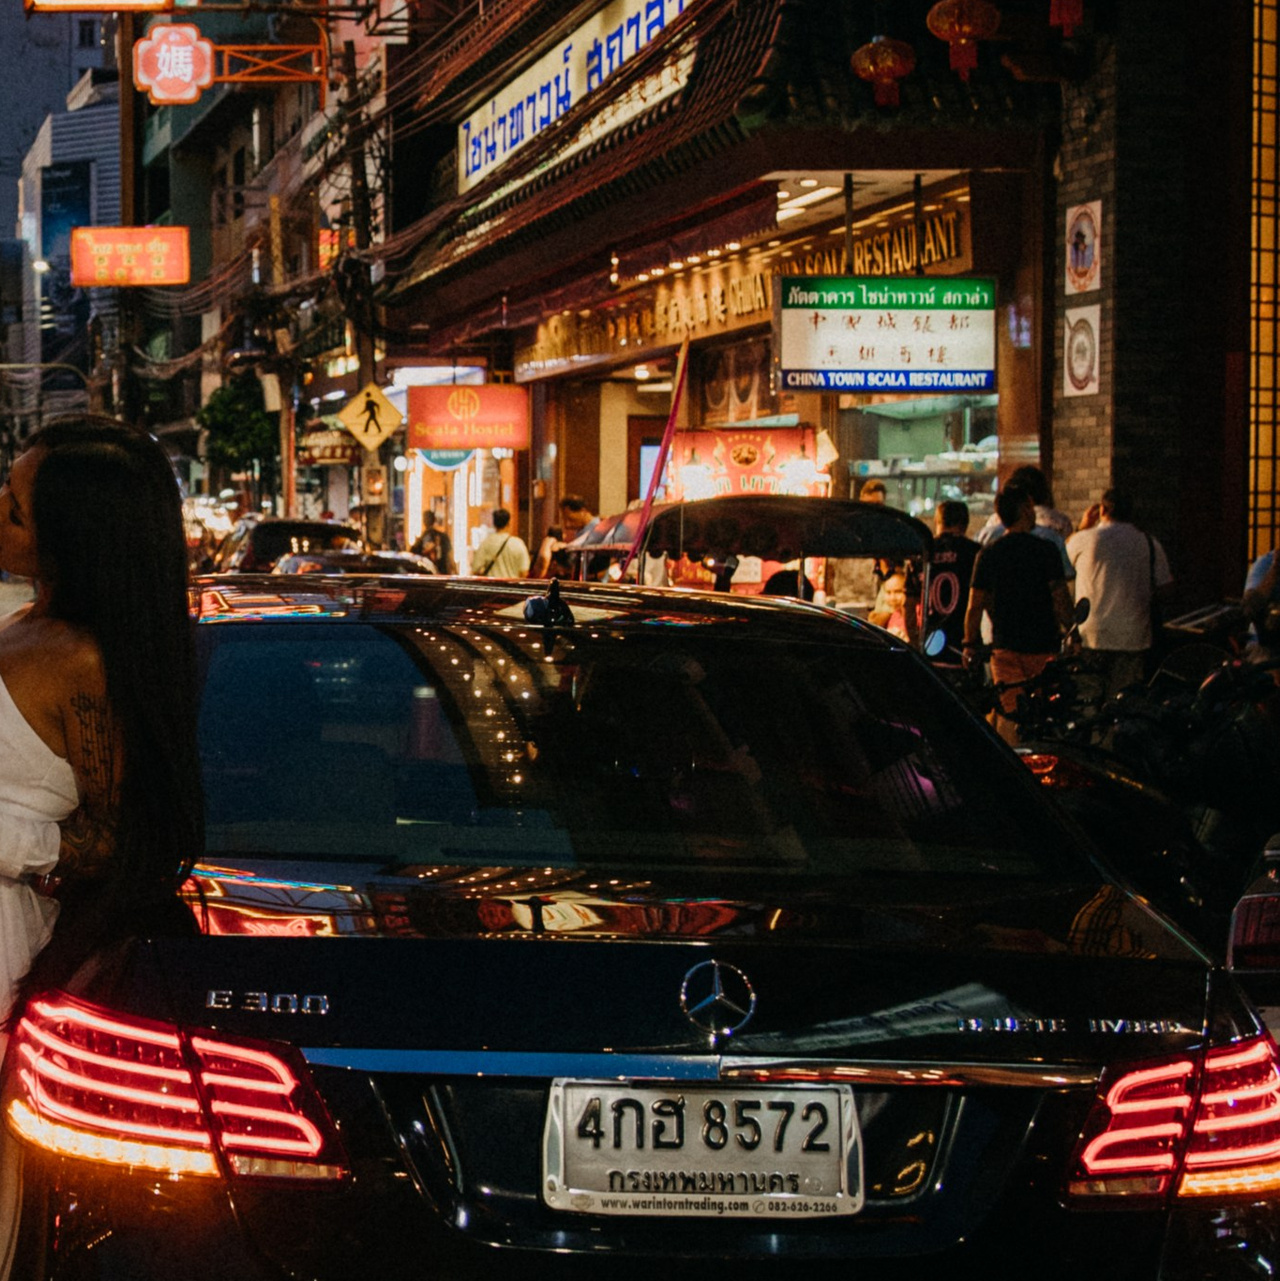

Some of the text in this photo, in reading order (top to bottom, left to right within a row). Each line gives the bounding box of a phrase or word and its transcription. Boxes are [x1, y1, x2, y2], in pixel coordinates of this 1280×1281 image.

[462, 42, 573, 179] ไชน่าทาวน์
[787, 284, 989, 305] ภัตตาคาร ไชน่าทาวน์ สกาล่า
[787, 372, 988, 387] CHINA TOWN SCALA RESTAURANT
[206, 990, 329, 1014] E 300
[701, 1099, 831, 1152] 8572
[606, 1170, 800, 1193] กรงเทพมหานคร
